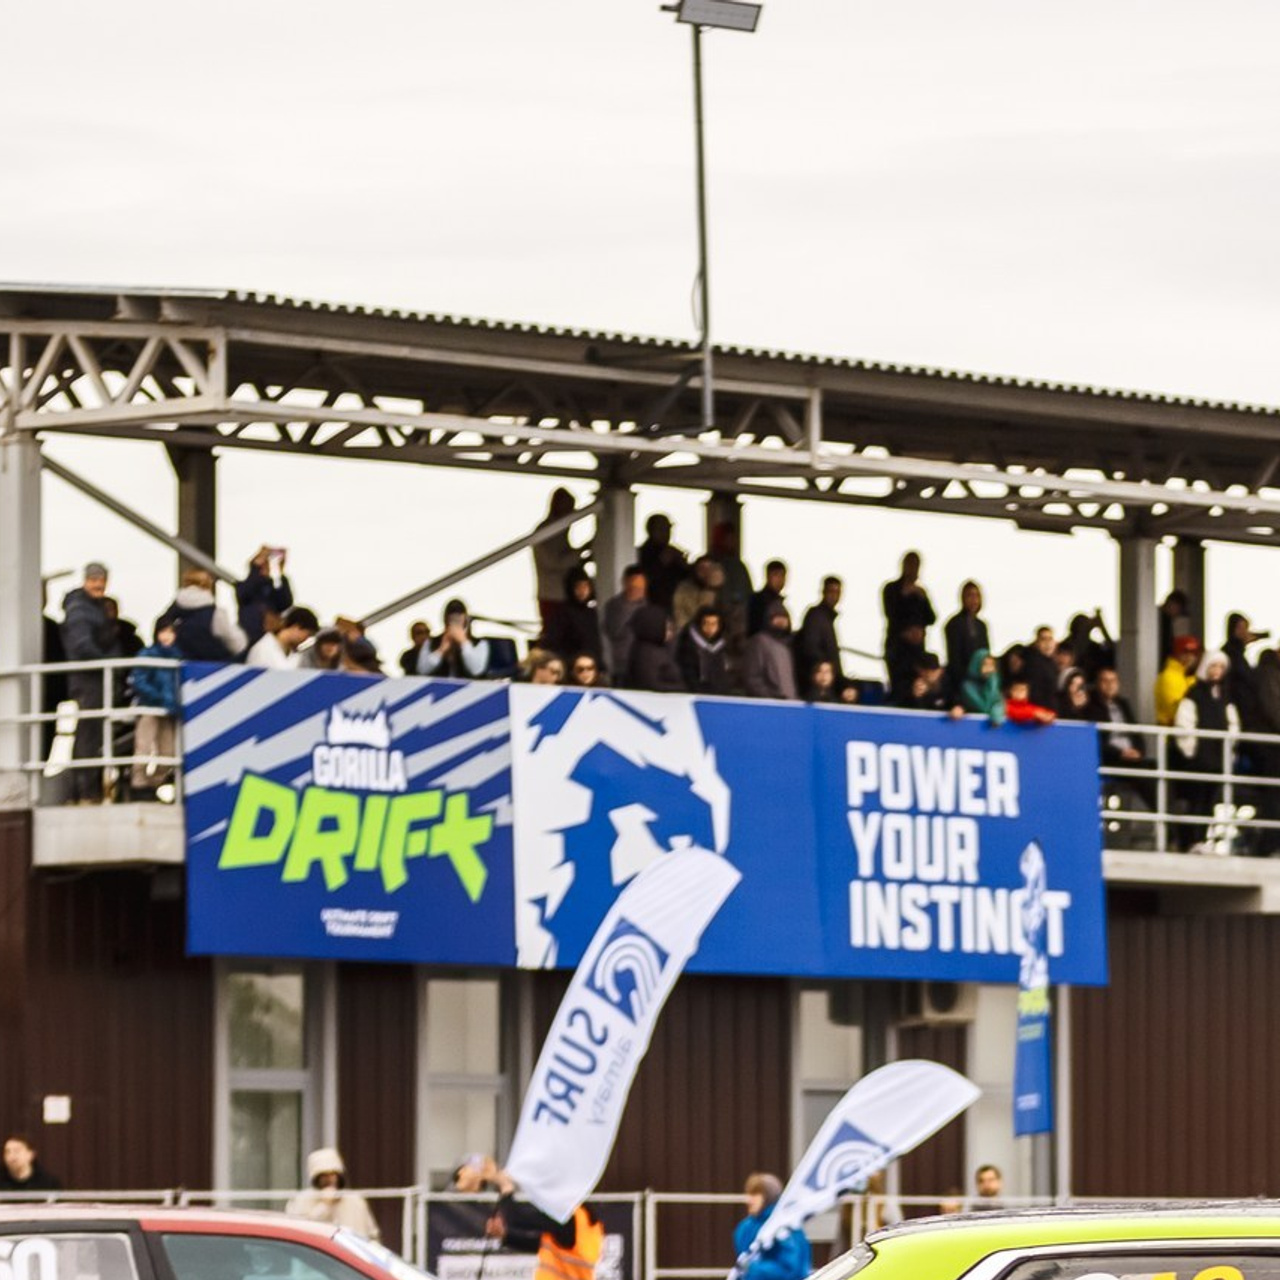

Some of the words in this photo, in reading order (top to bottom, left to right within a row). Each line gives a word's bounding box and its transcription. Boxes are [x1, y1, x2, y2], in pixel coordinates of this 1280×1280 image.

[312, 745, 407, 791] GORILLA
[846, 740, 1020, 818] POWER
[217, 772, 495, 904] DRIFT
[847, 810, 979, 884] YOUR
